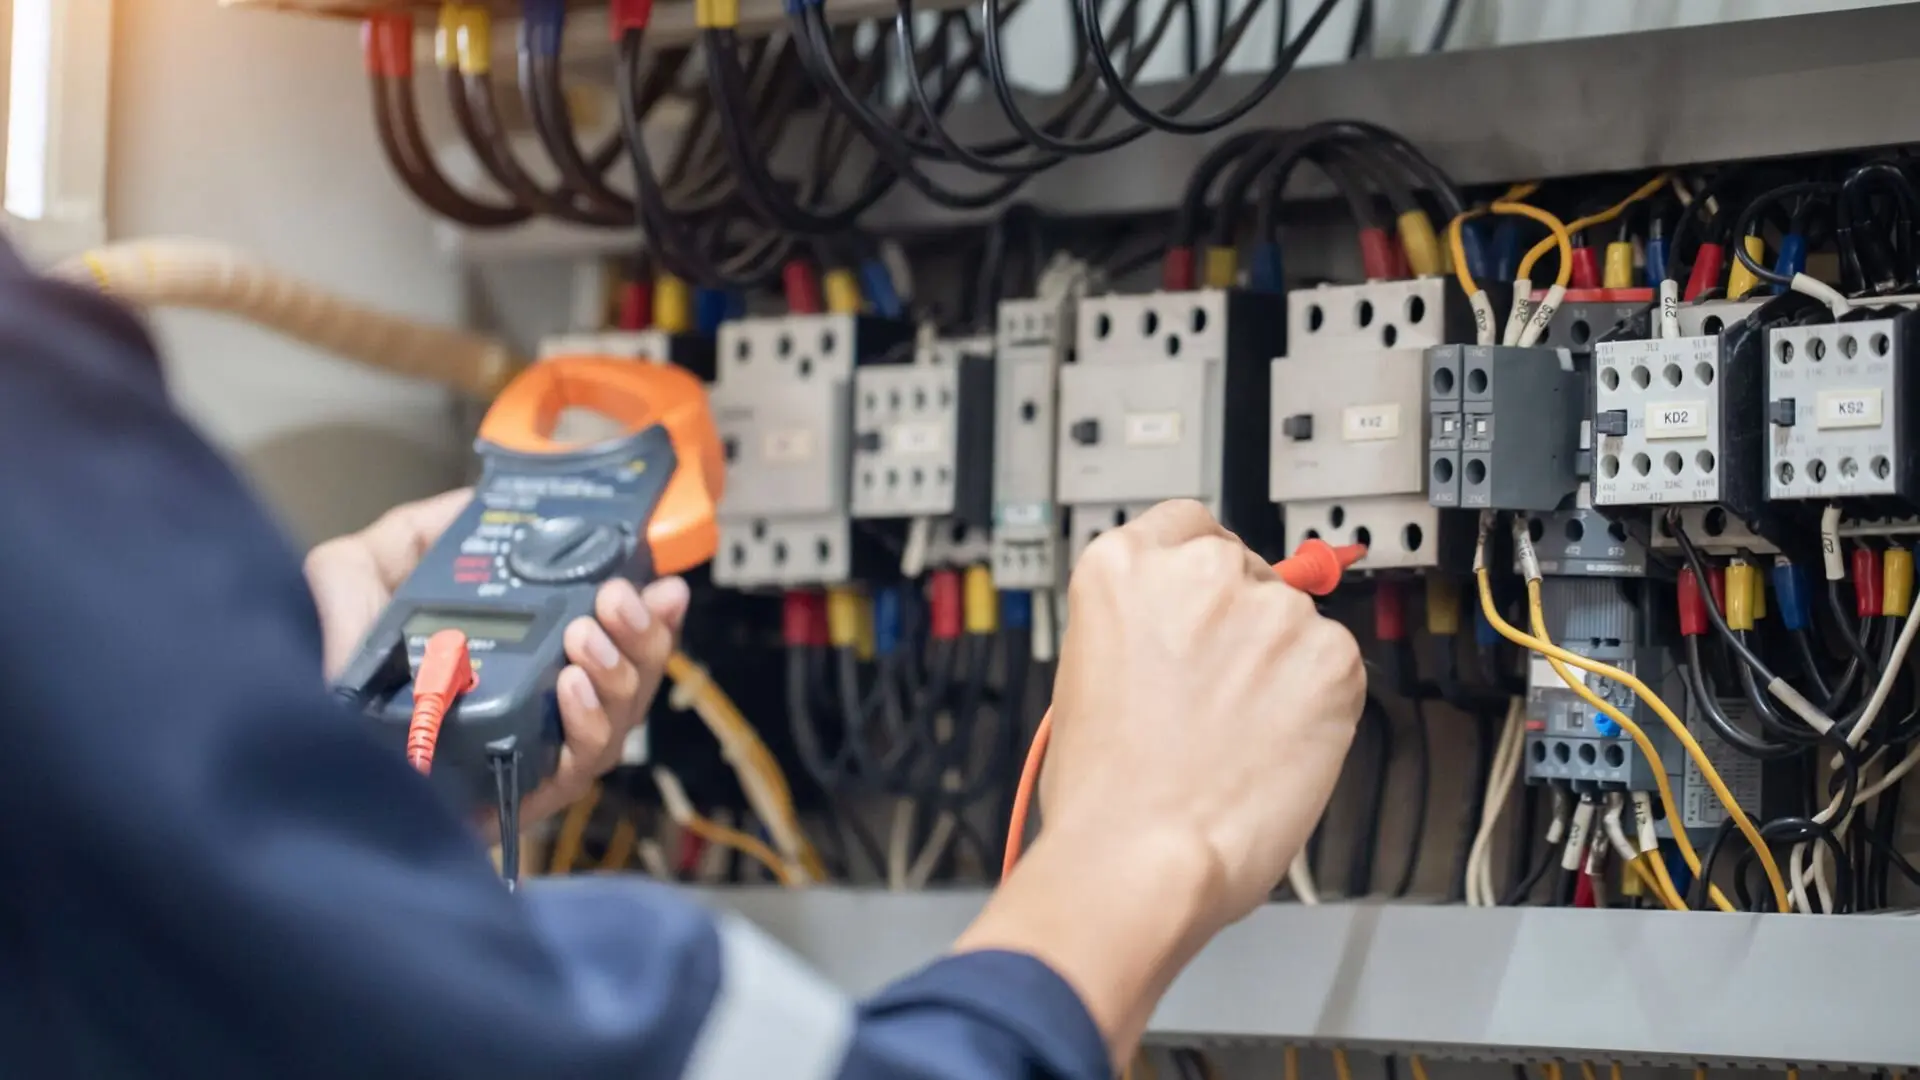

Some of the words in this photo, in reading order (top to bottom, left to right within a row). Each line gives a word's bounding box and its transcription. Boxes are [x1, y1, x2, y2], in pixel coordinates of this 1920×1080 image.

[1664, 296, 1677, 318] 2Y2
[1839, 401, 1864, 415] KS2
[1664, 411, 1688, 424] KD2
